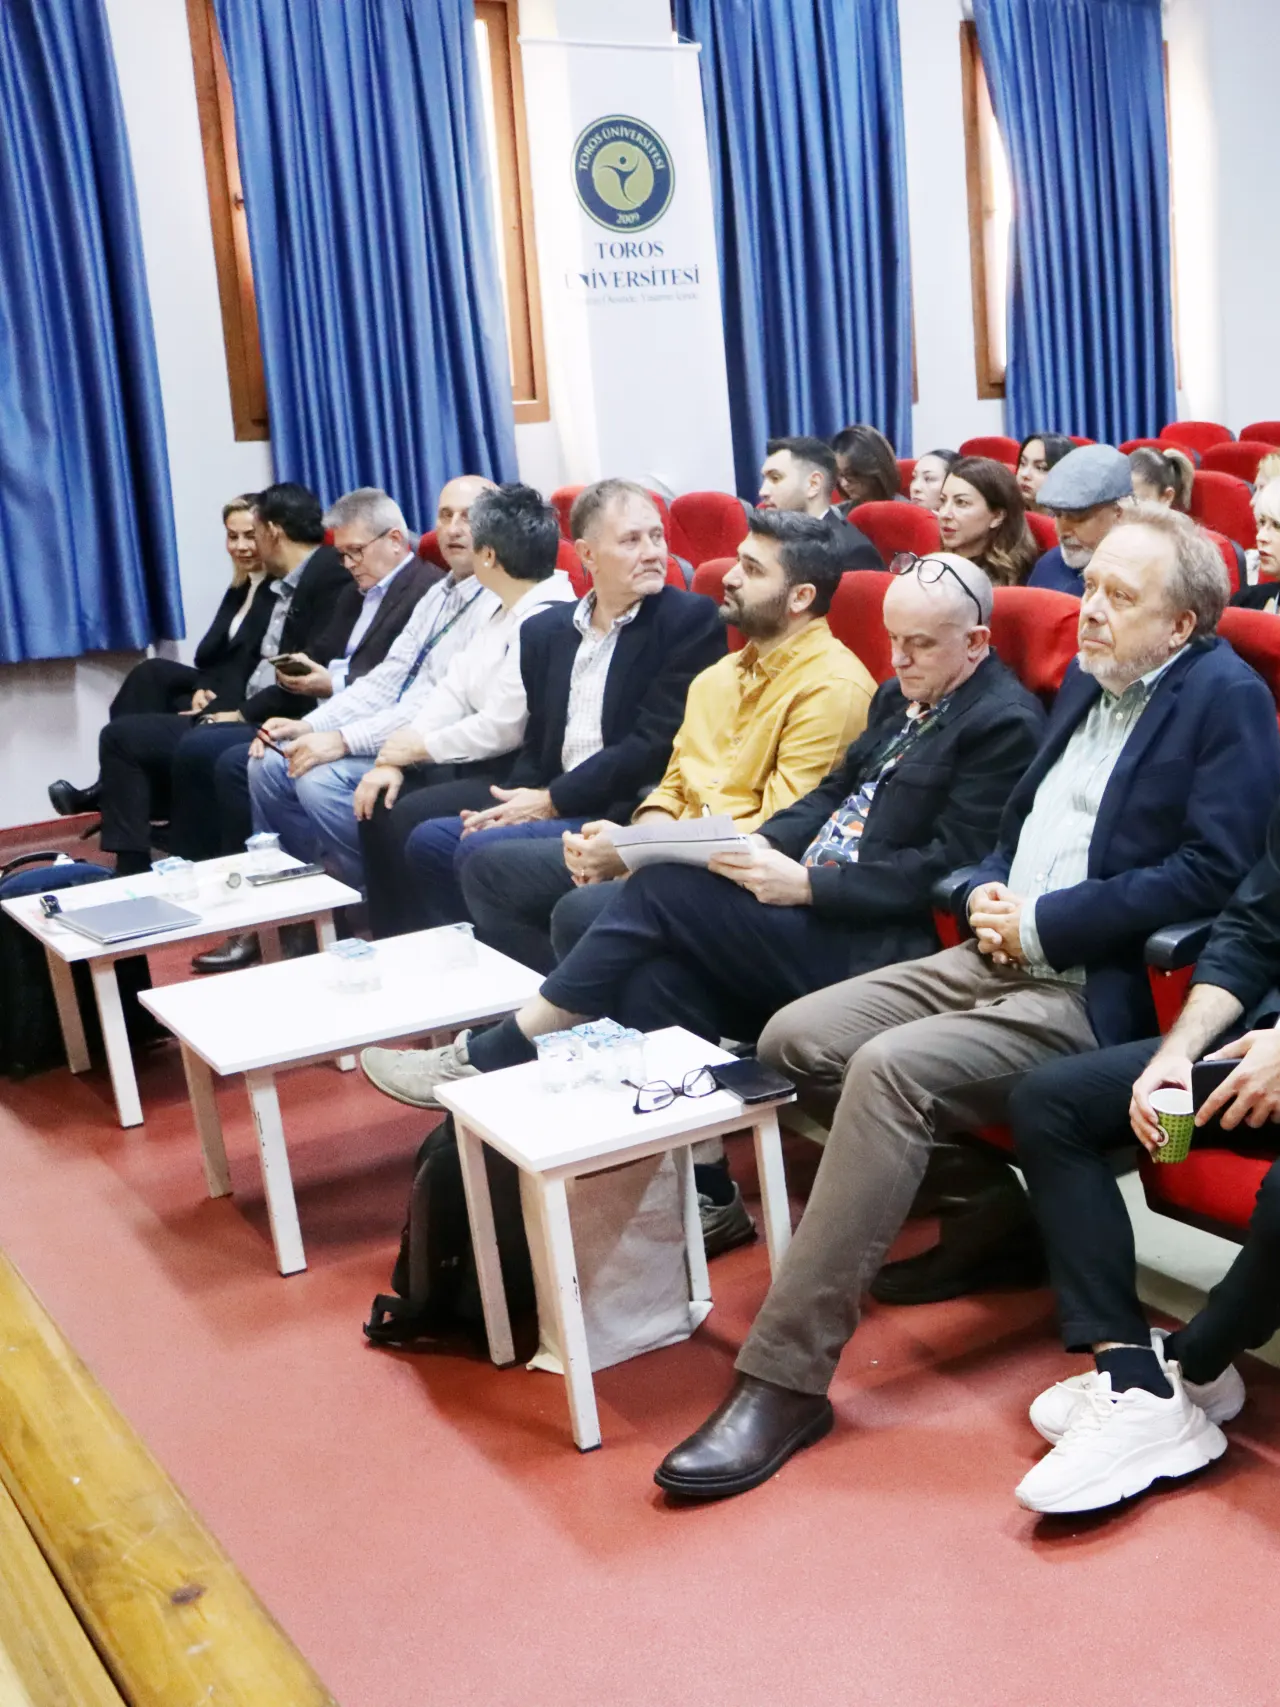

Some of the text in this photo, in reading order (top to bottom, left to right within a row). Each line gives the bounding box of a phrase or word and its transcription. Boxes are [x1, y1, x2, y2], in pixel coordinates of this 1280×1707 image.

[579, 132, 603, 171] TOROS
[616, 212, 640, 224] 2009
[594, 240, 664, 259] TOROS
